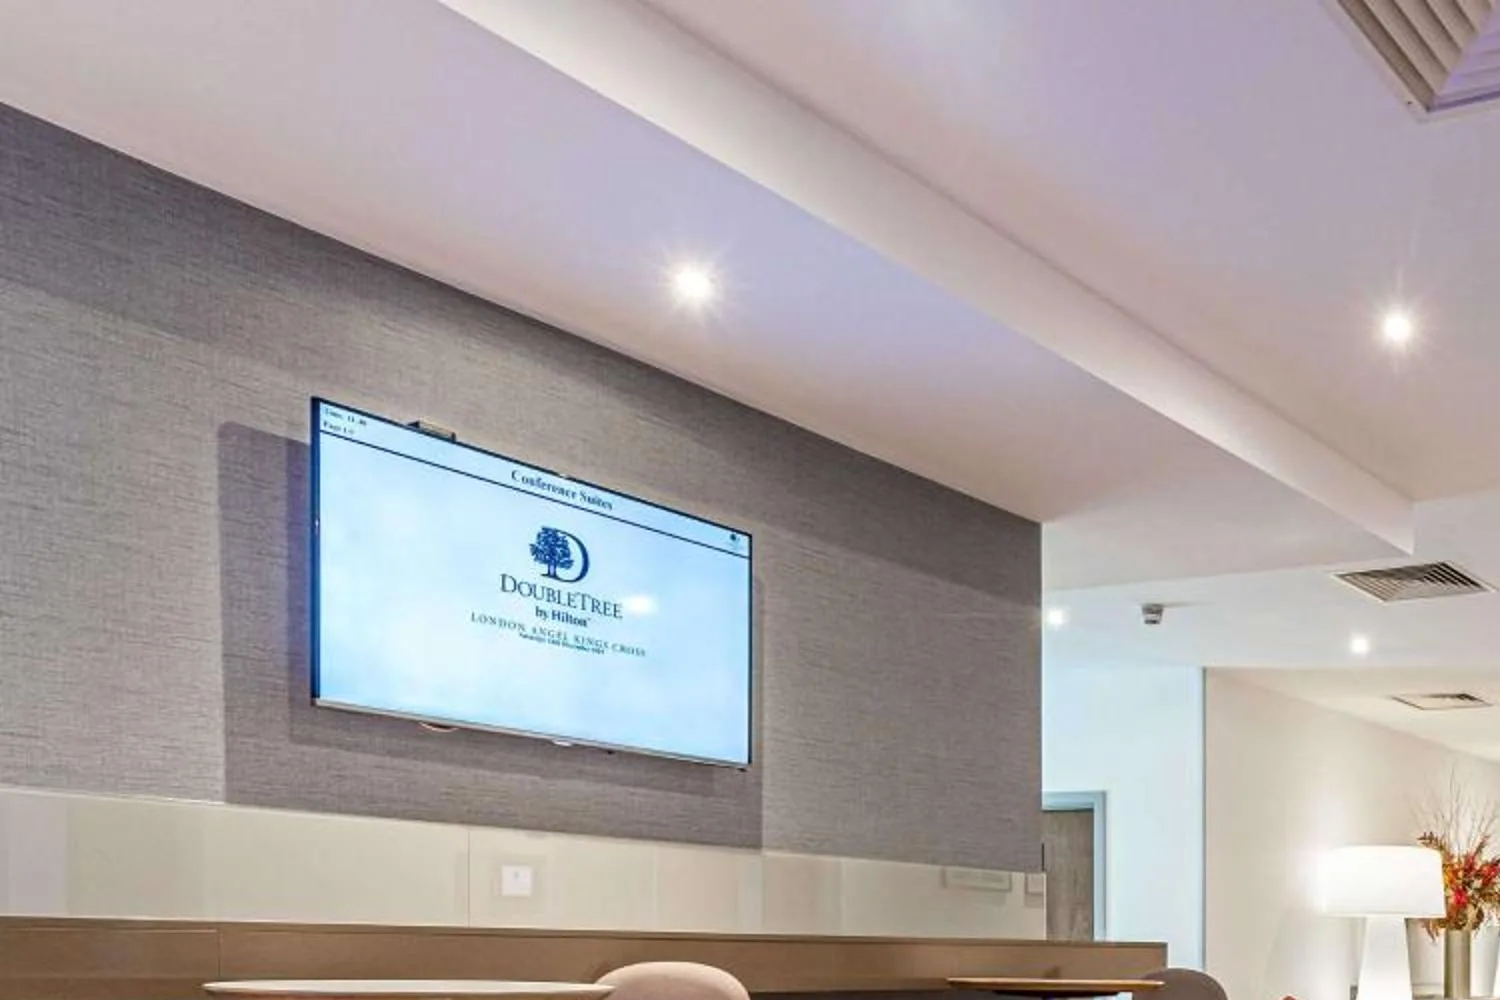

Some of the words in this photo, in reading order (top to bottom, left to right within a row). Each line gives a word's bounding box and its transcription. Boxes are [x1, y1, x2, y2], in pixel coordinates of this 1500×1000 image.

[511, 469, 577, 500] Conference
[579, 489, 613, 511] Suites
[500, 573, 623, 619] DOUBLETREE
[535, 606, 549, 620] by
[551, 609, 588, 627] Hilton
[471, 612, 526, 632] LONDON
[573, 634, 609, 649] KINGS
[611, 642, 646, 657] CROSS
